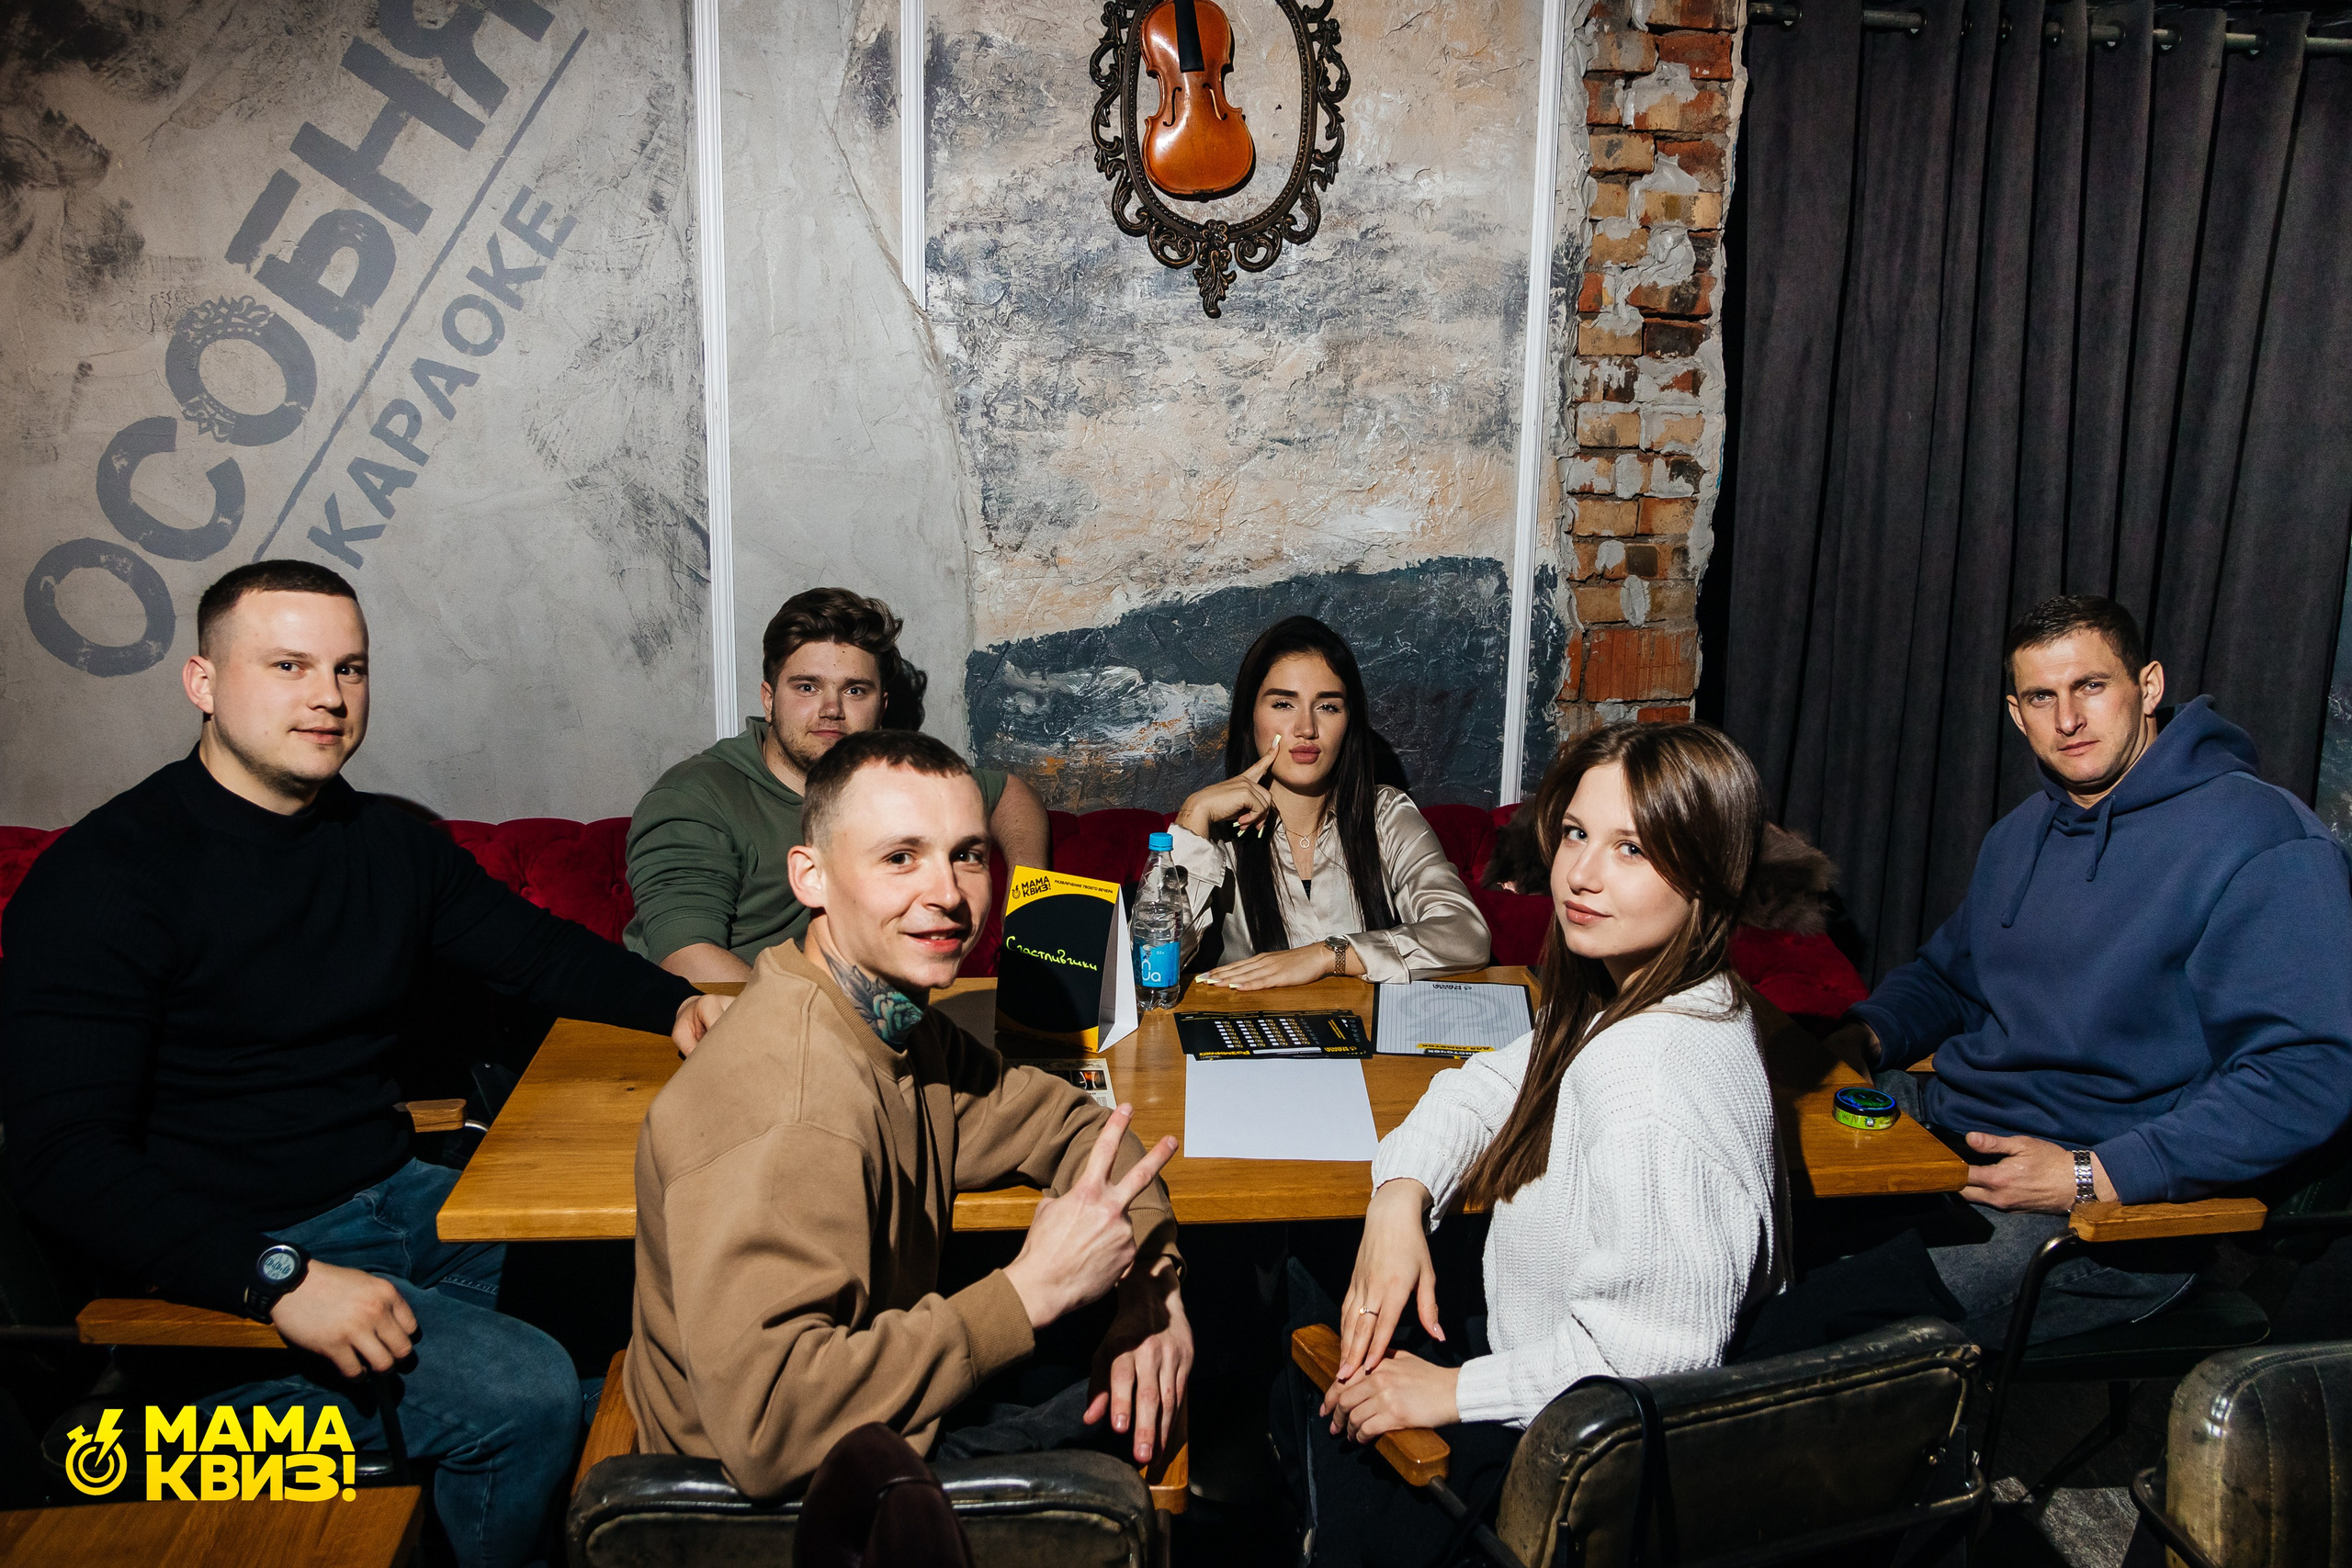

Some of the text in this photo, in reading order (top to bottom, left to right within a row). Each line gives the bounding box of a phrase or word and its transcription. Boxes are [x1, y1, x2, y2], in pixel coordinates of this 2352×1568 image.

[306, 184, 579, 570] КАРАОКЕ
[1021, 875, 1050, 890] МАМА
[1023, 882, 1052, 898] КВИЗ!
[1054, 879, 1082, 888] РАЗВЛЕЧЕНИЕ
[1005, 935, 1098, 972] Счастливчики
